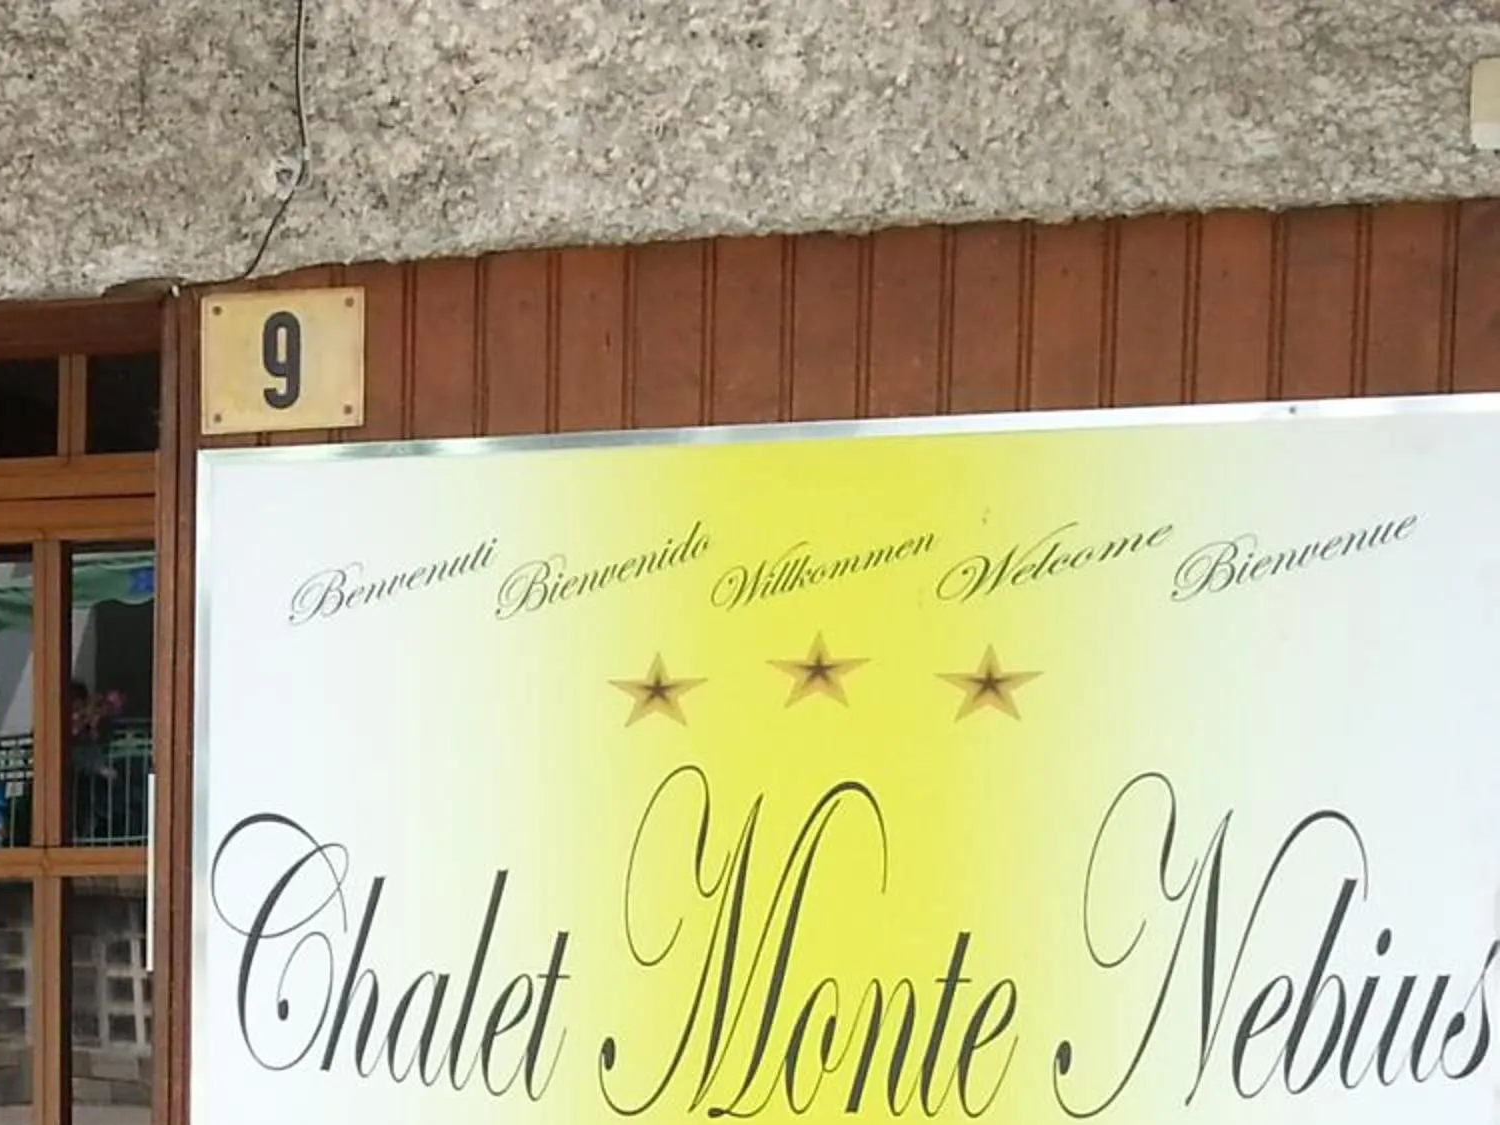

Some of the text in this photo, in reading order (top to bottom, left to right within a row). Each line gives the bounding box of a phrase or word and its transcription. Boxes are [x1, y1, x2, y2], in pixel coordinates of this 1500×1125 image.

[261, 310, 301, 409] 9
[288, 512, 1420, 626] Benvenuti Bienvenido Willkommen Welcome Bienvenue
[210, 764, 1500, 1119] Chalet Monte Nebius
